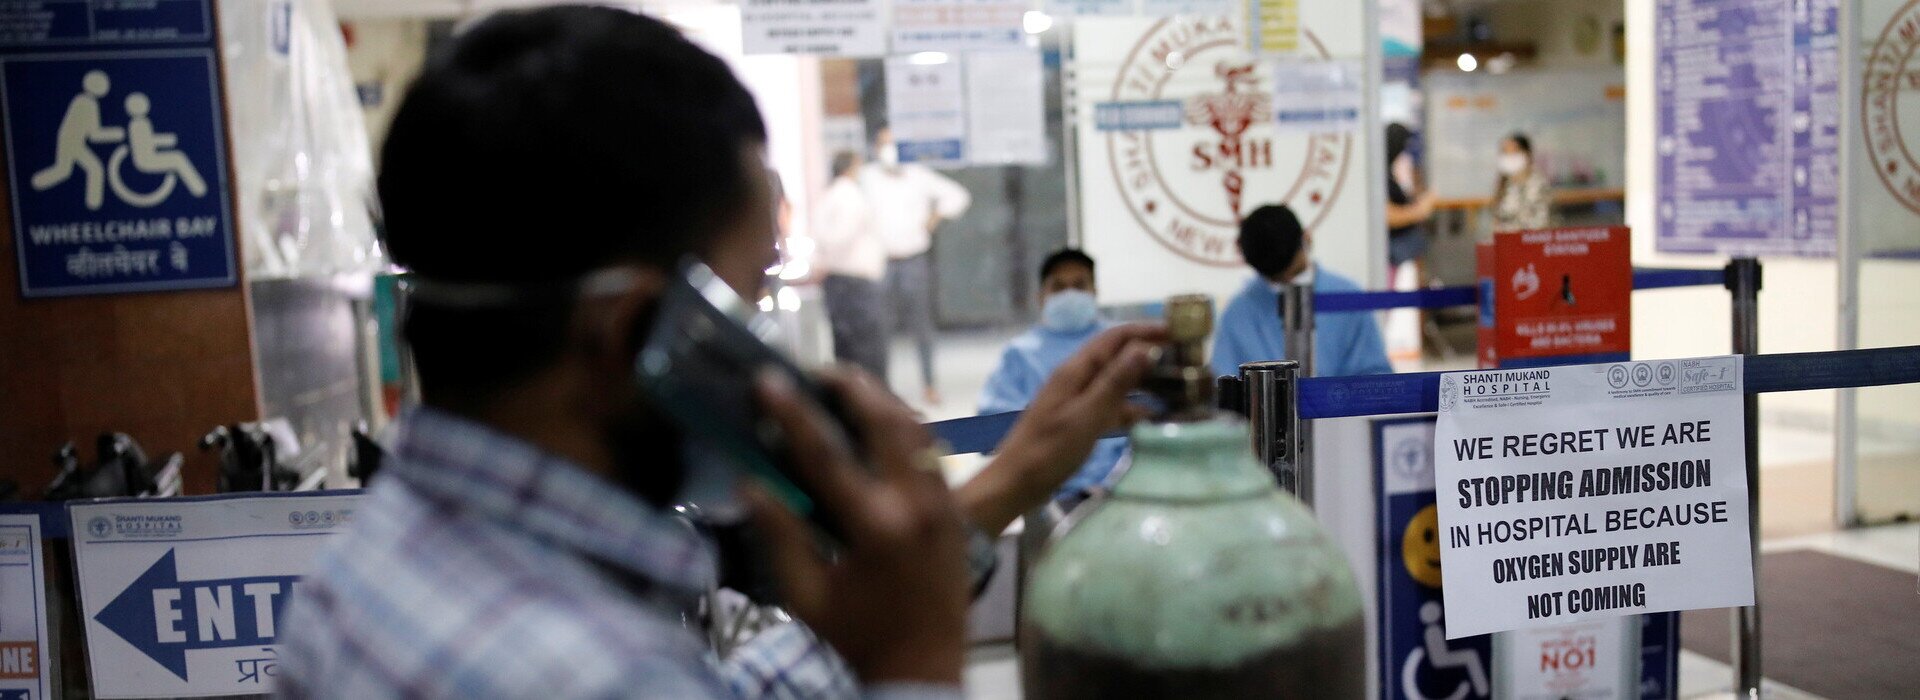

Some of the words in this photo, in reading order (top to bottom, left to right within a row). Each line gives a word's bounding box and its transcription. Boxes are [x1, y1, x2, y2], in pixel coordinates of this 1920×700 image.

[1191, 139, 1272, 170] SMH
[30, 217, 172, 245] WHEELCHAIR
[175, 215, 217, 238] BAY
[1464, 374, 1502, 384] SHANTI
[1506, 370, 1550, 382] MUKAND
[1464, 382, 1550, 395] HOSPITAL
[1682, 384, 1708, 393] CERTIFIED
[1708, 383, 1734, 391] HOSPITAL
[1454, 436, 1493, 461] WE
[1502, 428, 1609, 458] REGRET
[1616, 425, 1655, 449] WE
[1661, 420, 1711, 446] ARE
[1458, 470, 1574, 509] STOPPING
[1578, 459, 1711, 498] ADMISSION
[116, 521, 182, 529] HOSPITAL
[1450, 524, 1470, 549] IN
[1478, 513, 1597, 545] HOSPITAL
[1605, 501, 1728, 532] BECAUSE
[1493, 553, 1564, 584] OXYGEN
[1568, 545, 1639, 574] SUPPLY
[1643, 541, 1681, 567] ARE
[152, 582, 302, 643] ENT
[1528, 592, 1563, 619] NOT
[1567, 582, 1646, 615] COMING
